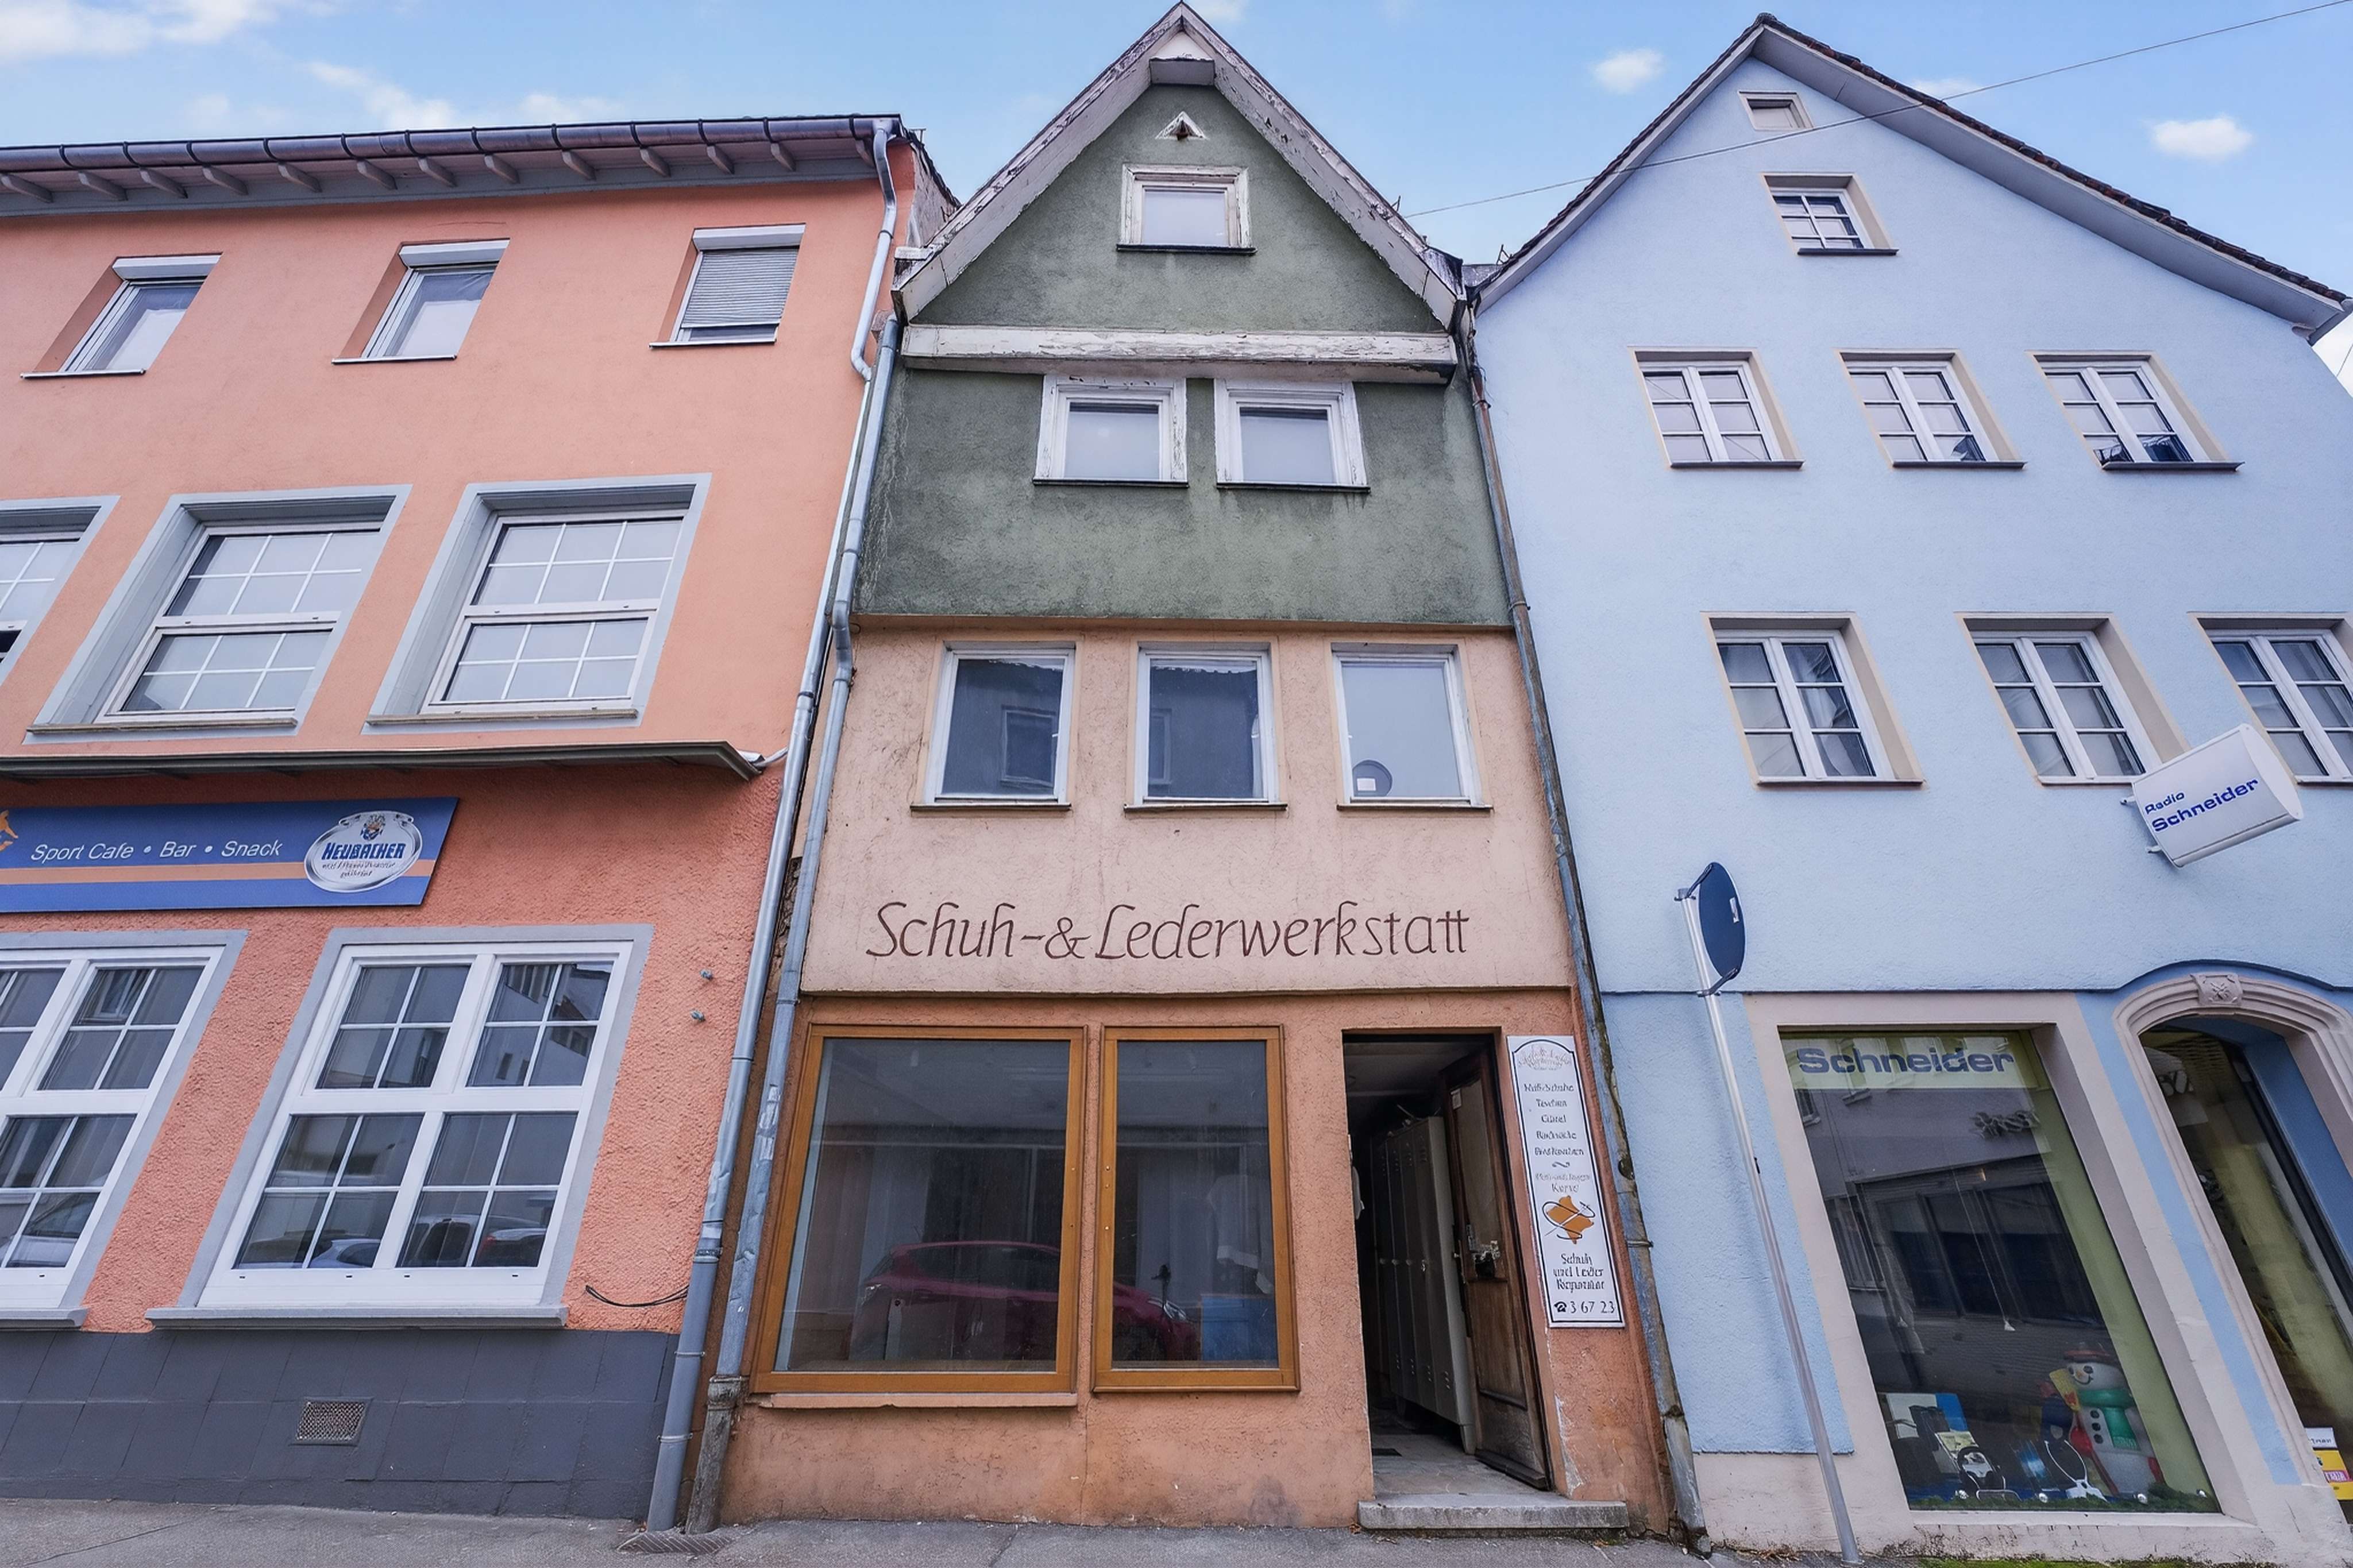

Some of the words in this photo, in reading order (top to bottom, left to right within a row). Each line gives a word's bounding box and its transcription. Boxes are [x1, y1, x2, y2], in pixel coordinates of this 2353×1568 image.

[2144, 792, 2185, 815] Radio
[2151, 778, 2259, 832] Schneider
[30, 844, 85, 864] Sport
[88, 842, 134, 860] Cafe
[160, 841, 196, 858] Bar
[221, 839, 283, 857] Snack
[1095, 901, 1470, 959] Lederwerkstatt
[1797, 1046, 2014, 1073] Schneider
[1569, 1301, 1577, 1314] 3
[1580, 1301, 1595, 1314] 67
[1600, 1300, 1615, 1314] 23
